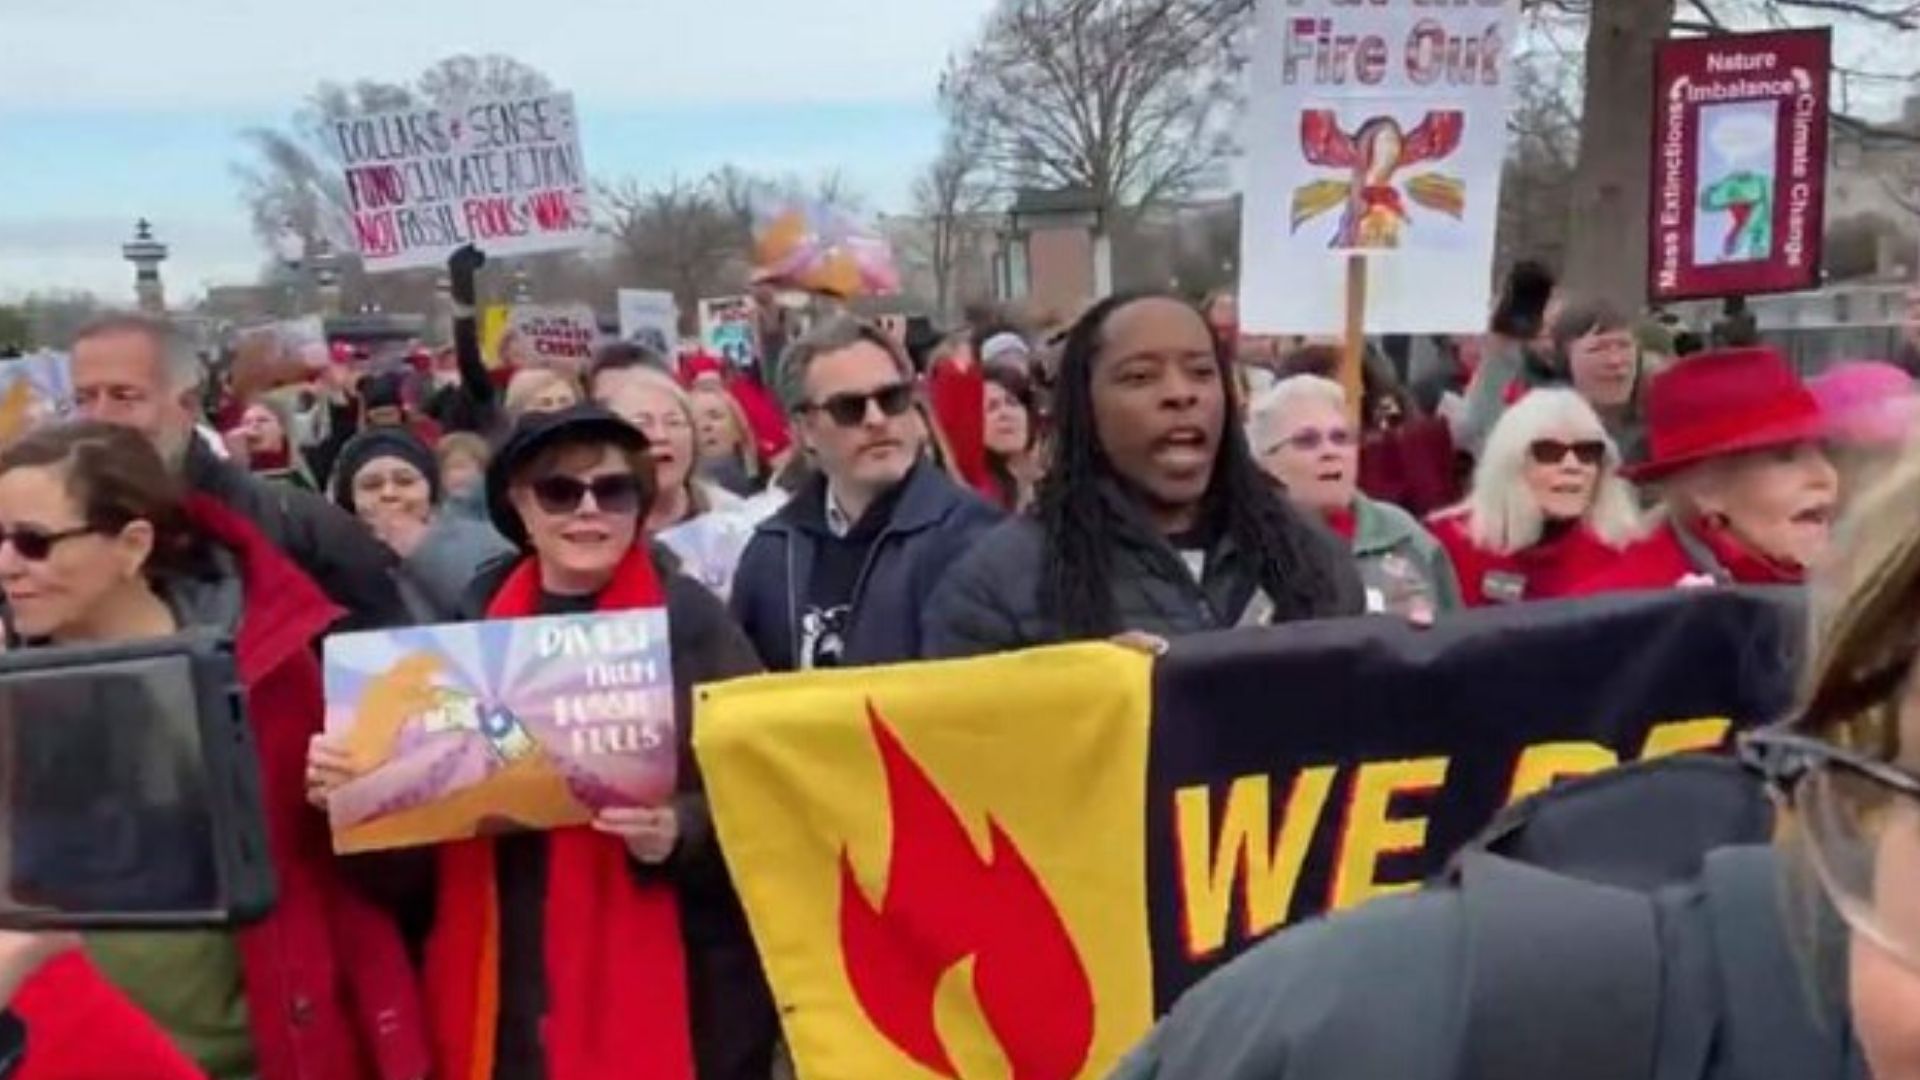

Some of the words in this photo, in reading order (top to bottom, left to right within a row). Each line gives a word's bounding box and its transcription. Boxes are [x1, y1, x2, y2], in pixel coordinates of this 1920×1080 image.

[1282, 17, 1388, 85] Fire
[1405, 17, 1503, 85] Out
[1706, 52, 1777, 72] Nature
[1687, 78, 1795, 101] Imbalance
[1661, 101, 1685, 227] Extinctions
[1791, 93, 1816, 179] Climate
[345, 163, 406, 212] FUND
[405, 152, 504, 202] CLIMATE
[505, 141, 586, 196] ACTION
[355, 210, 400, 258] NOT
[396, 203, 467, 250] FOSSIL
[1783, 182, 1811, 266] Change
[1659, 231, 1679, 290] Mass
[1173, 755, 1451, 962] WE
